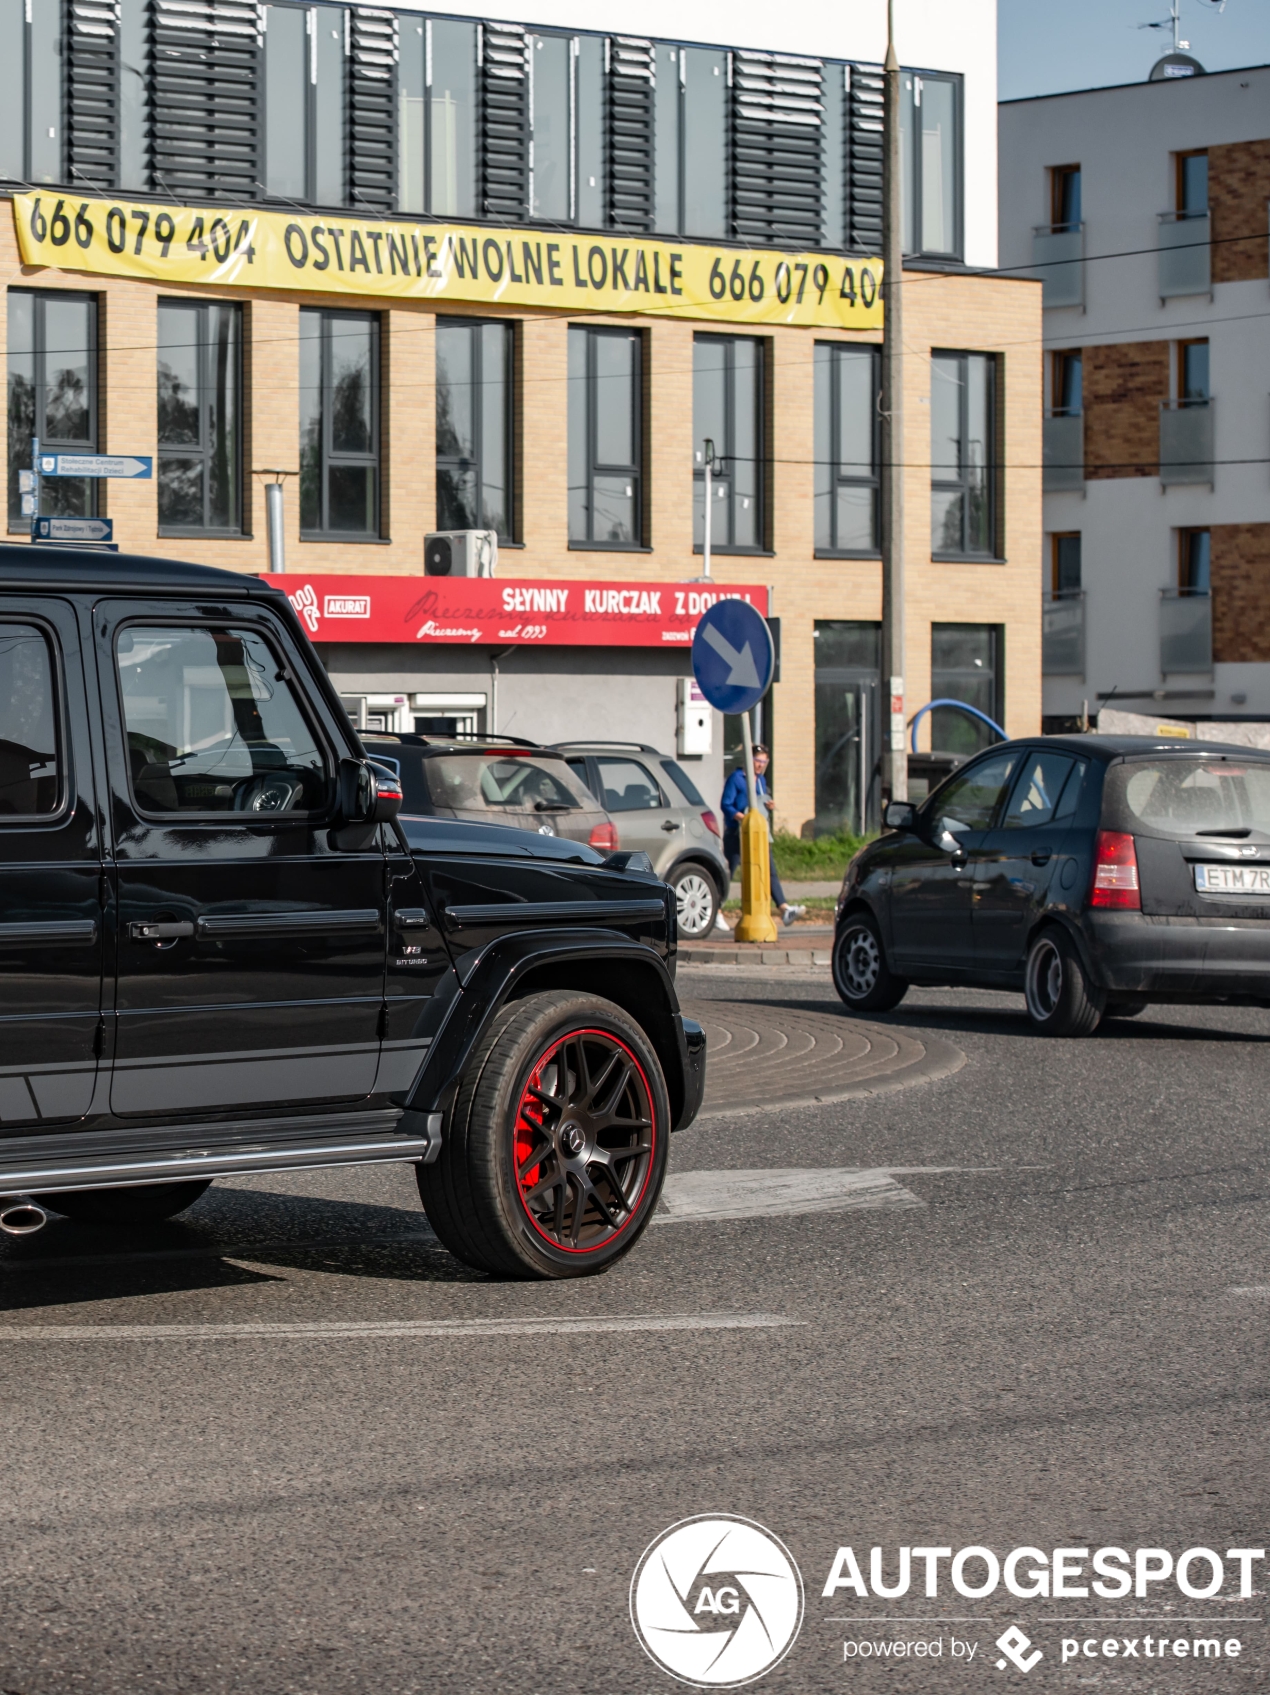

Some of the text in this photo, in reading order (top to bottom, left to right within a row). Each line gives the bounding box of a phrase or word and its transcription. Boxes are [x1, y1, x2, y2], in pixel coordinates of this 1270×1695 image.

[30, 197, 884, 308] 666 079 404 OSTATNIE WOLNE LOKALE 666 079 40
[328, 600, 366, 613] AKURAT
[502, 587, 569, 612] SŁYNNY
[584, 589, 661, 615] KURCZAK
[674, 591, 686, 615] Z
[1207, 868, 1245, 887] ETM
